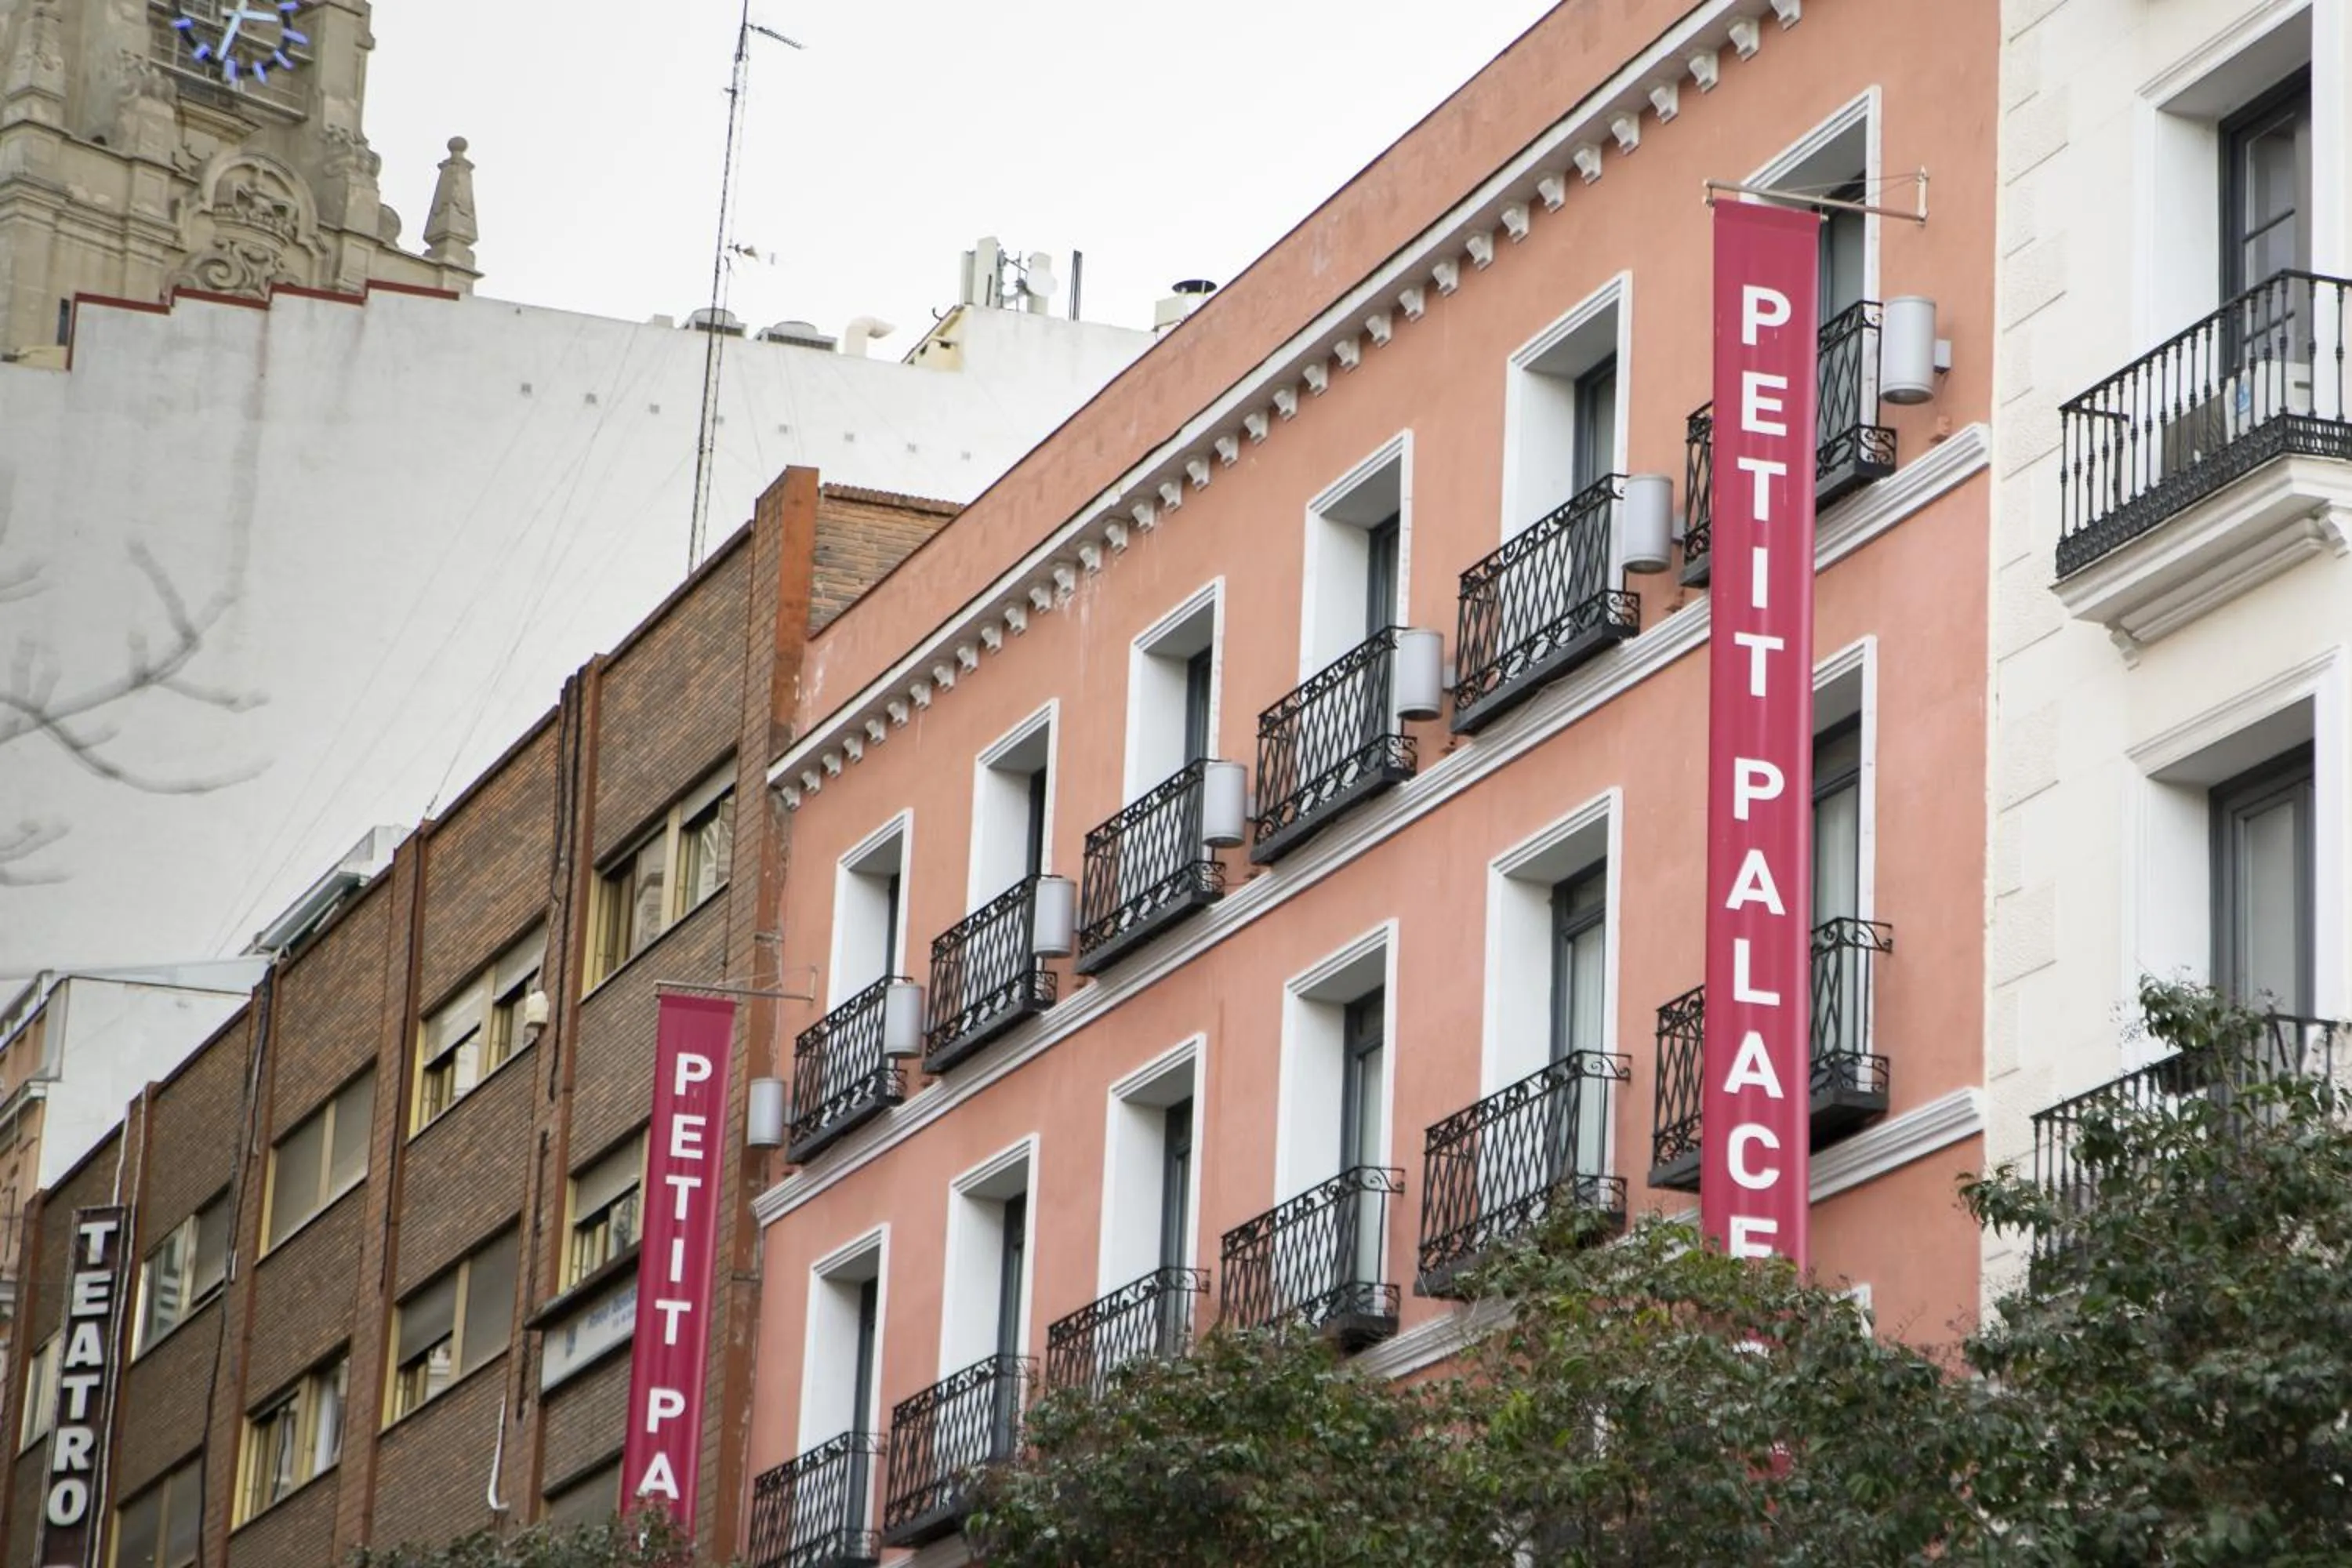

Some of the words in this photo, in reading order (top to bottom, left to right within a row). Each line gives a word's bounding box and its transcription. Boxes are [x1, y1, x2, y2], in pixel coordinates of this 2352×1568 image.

[1733, 284, 1792, 699] PETIT
[1724, 756, 1786, 1261] PALACE
[654, 1051, 713, 1346] PETIT
[47, 1220, 118, 1526] TEATRO
[635, 1387, 687, 1548] PA
